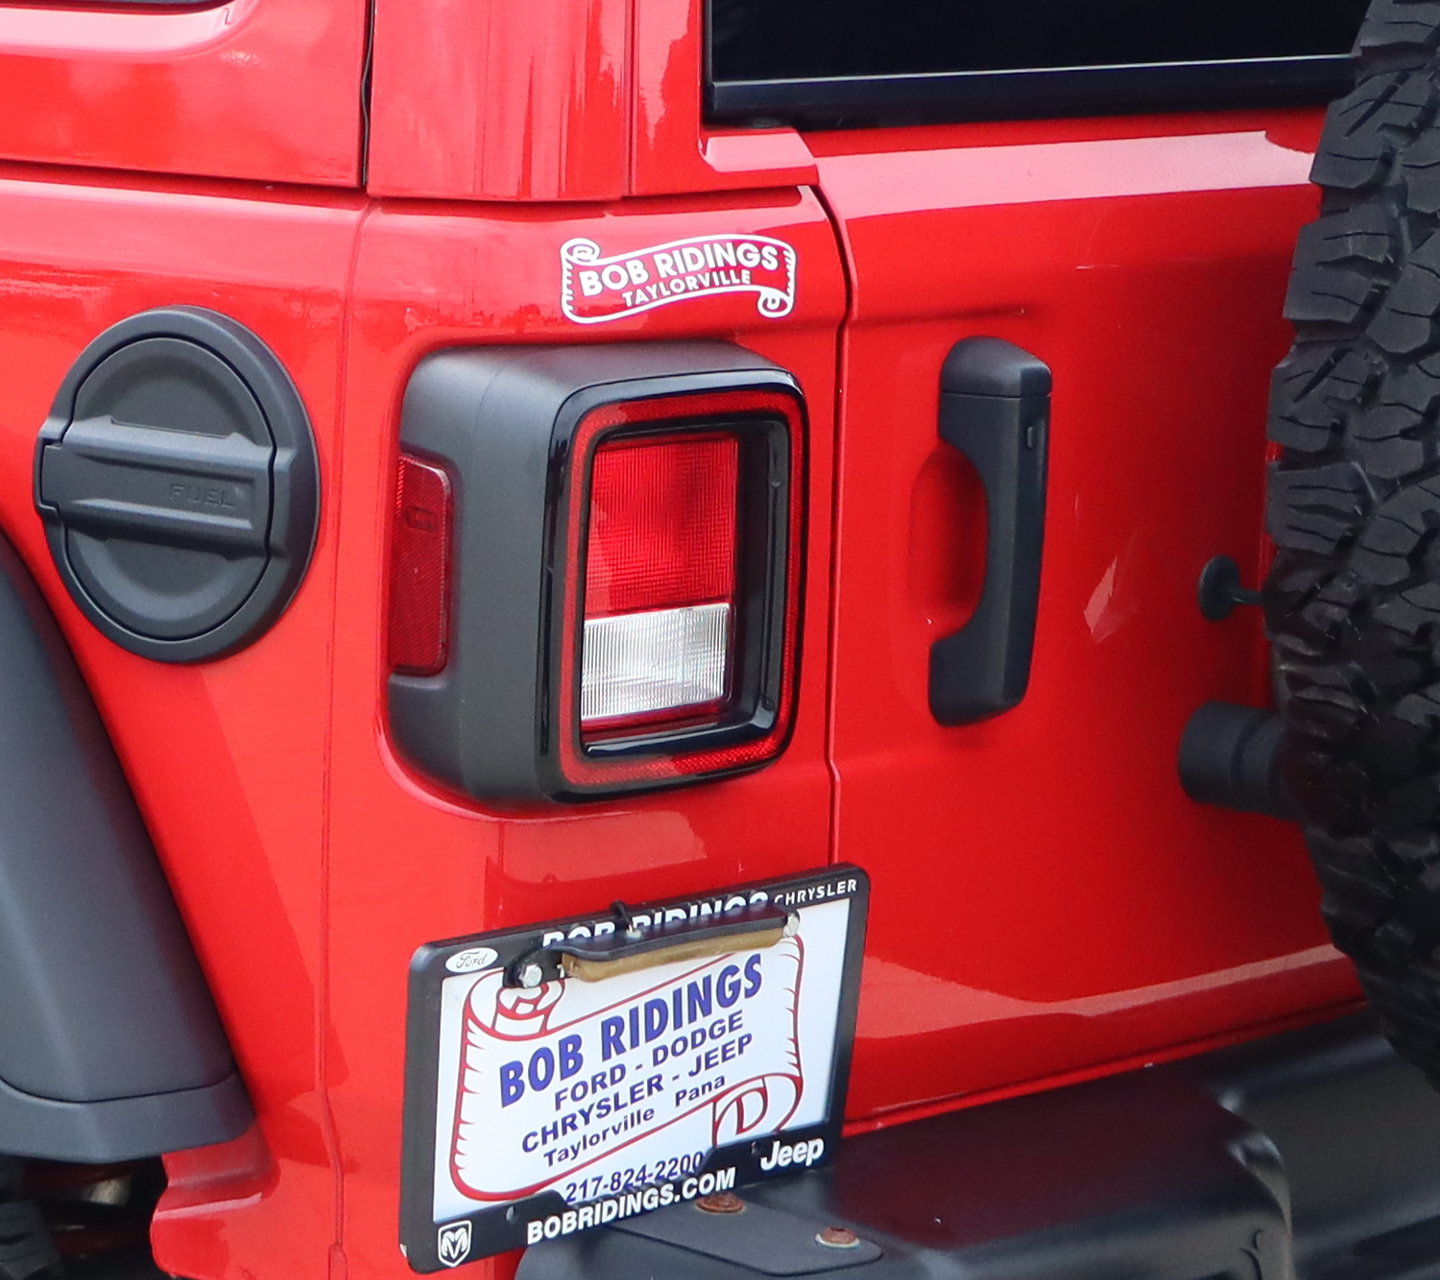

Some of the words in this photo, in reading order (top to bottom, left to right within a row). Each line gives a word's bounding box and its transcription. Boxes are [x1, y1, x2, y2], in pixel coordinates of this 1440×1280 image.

[579, 259, 649, 297] BOB
[653, 242, 778, 278] RIDINGS
[622, 269, 751, 308] TAYLORVILLE
[168, 483, 236, 509] FUEL
[773, 878, 858, 906] CHRYSLER
[455, 950, 488, 970] Ford
[499, 1033, 584, 1109] BOB
[601, 953, 762, 1062] RIDINGS
[555, 1063, 626, 1112] FORD
[652, 1009, 743, 1067] DODGE
[522, 1073, 664, 1153] CHRYSLER
[688, 1032, 753, 1078] JEEP
[543, 1107, 655, 1167] Taylorville
[675, 1074, 726, 1108] Pana
[565, 1150, 704, 1203] 217-824-2200
[760, 1137, 825, 1171] Jeep
[527, 1166, 737, 1245] BOBRIDINGS.COM
